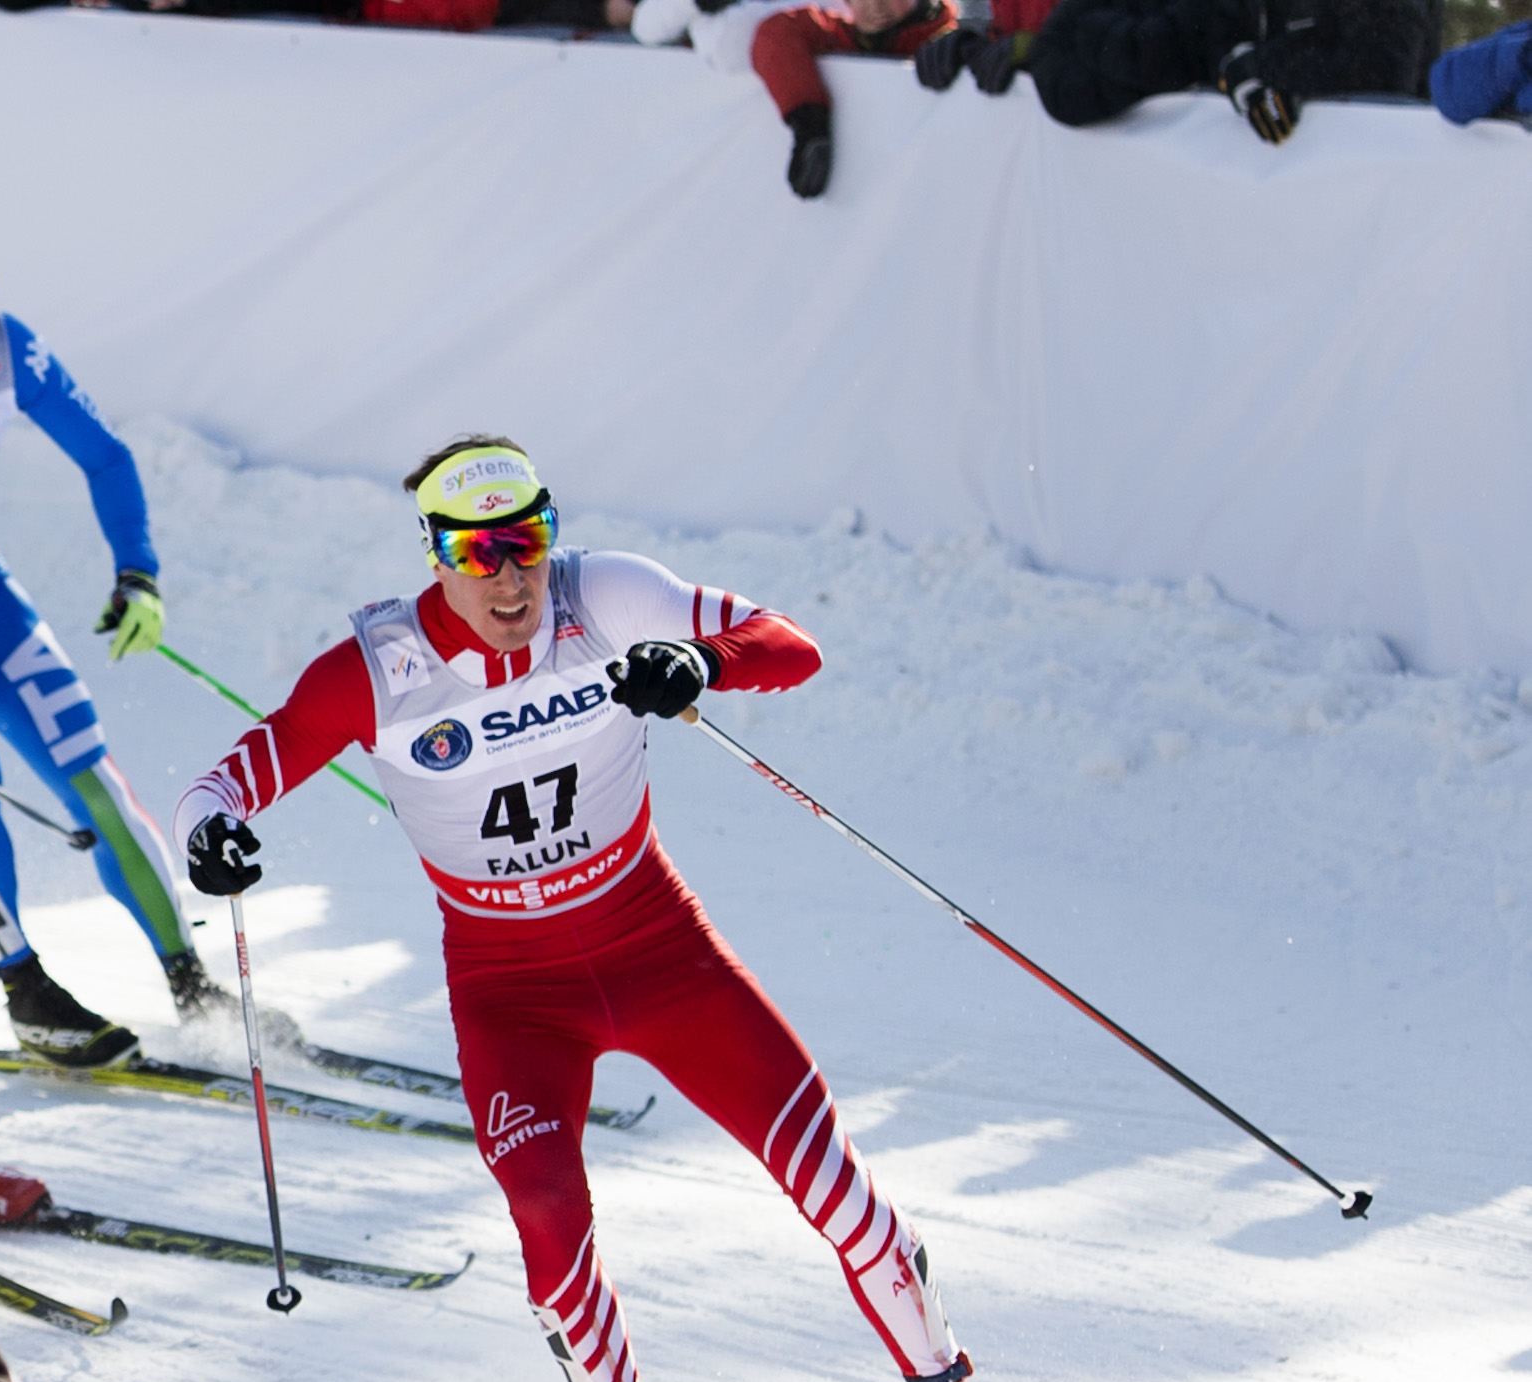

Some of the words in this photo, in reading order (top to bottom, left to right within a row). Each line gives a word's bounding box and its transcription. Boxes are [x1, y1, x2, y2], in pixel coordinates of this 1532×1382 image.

[481, 682, 607, 742] SAAB
[486, 733, 536, 756] Defence
[538, 725, 562, 740] and
[564, 705, 613, 733] Security
[480, 763, 578, 846] 47
[467, 847, 623, 911] VIESSMANN
[487, 831, 591, 876] FALUN
[486, 1119, 562, 1168] Löffler
